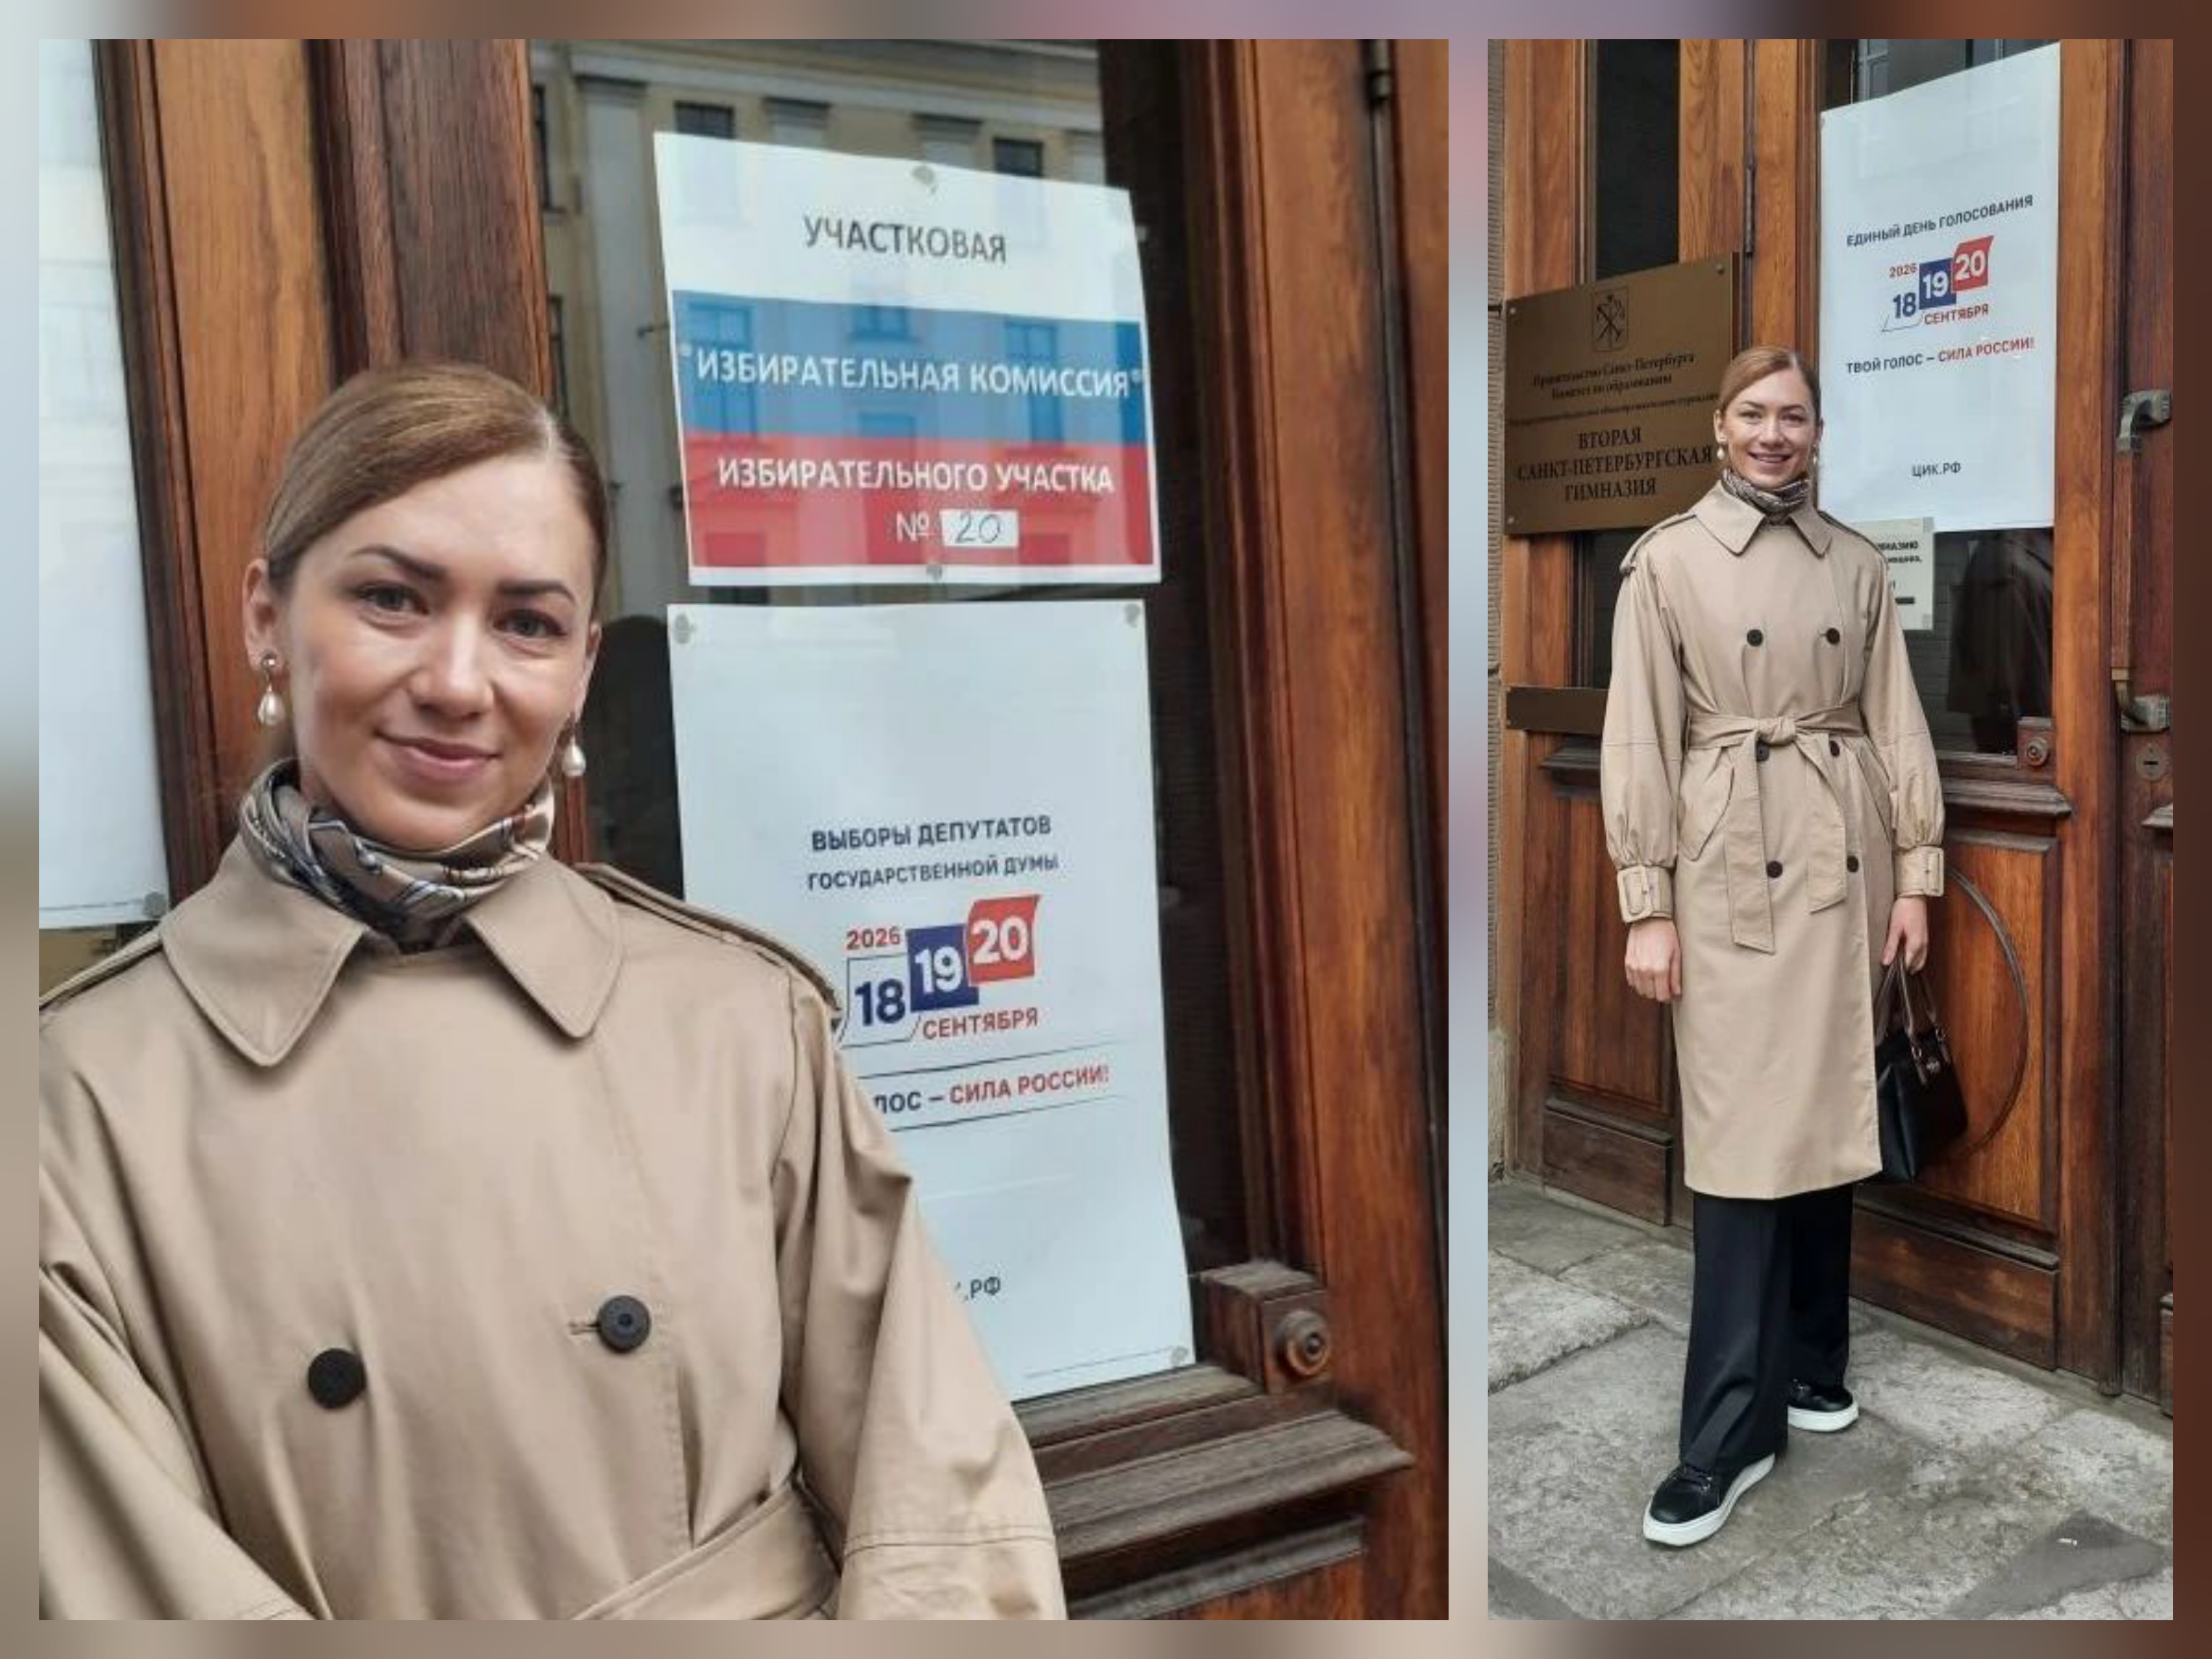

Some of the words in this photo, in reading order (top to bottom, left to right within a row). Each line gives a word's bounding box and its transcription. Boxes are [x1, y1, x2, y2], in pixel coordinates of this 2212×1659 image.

[804, 215, 1008, 262] УЧАСТКОВАЯ
[1846, 224, 1901, 247] ЕДИНЫЙ
[1903, 217, 1936, 237] ДЕНЬ
[1939, 194, 2033, 229] ГОЛОСОВАНИЯ
[1889, 263, 1917, 279] 2026
[1892, 291, 1917, 320] 18
[1923, 270, 1948, 299] 19
[1955, 249, 1985, 281] 20
[1924, 303, 1989, 326] СЕНТЯБРЯ
[696, 347, 960, 393] ИЗБИРАТЕЛЬНАЯ
[970, 365, 1129, 399] КОМИССИЯ
[1846, 357, 1881, 374] ТВОЙ
[1884, 352, 1923, 371] ГОЛОС
[1938, 345, 1973, 363] СИЛА
[1976, 337, 2035, 357] РОССИИ!
[1577, 427, 1641, 450] ВТОРАЯ
[717, 457, 987, 492] ИЗБИРАТЕЛЬНОГО
[996, 463, 1115, 493] УЧАСТКА
[1517, 444, 1712, 481] САНКТ-ПЕТЕРБУРГСКАЯ
[1912, 461, 1961, 477] ЦИК.РФ
[1565, 477, 1656, 502] ГИМНАЗИЯ
[896, 512, 930, 542] №
[954, 513, 1001, 544] 20
[811, 827, 910, 852] ВЫБОРЫ
[918, 815, 1051, 846] ДЕПУТАТОВ
[807, 855, 998, 891] ГОСУДАРСТВЕННОЙ
[1003, 854, 1059, 876] ДУМЫ
[846, 926, 901, 950] 2026
[855, 979, 906, 1026] 18
[914, 946, 964, 995] 19
[972, 916, 1028, 966] 20
[922, 1007, 1039, 1041] СЕНТЯБРЯ
[950, 1080, 1012, 1105] СИЛА
[1018, 1064, 1109, 1096] РОССИИ!
